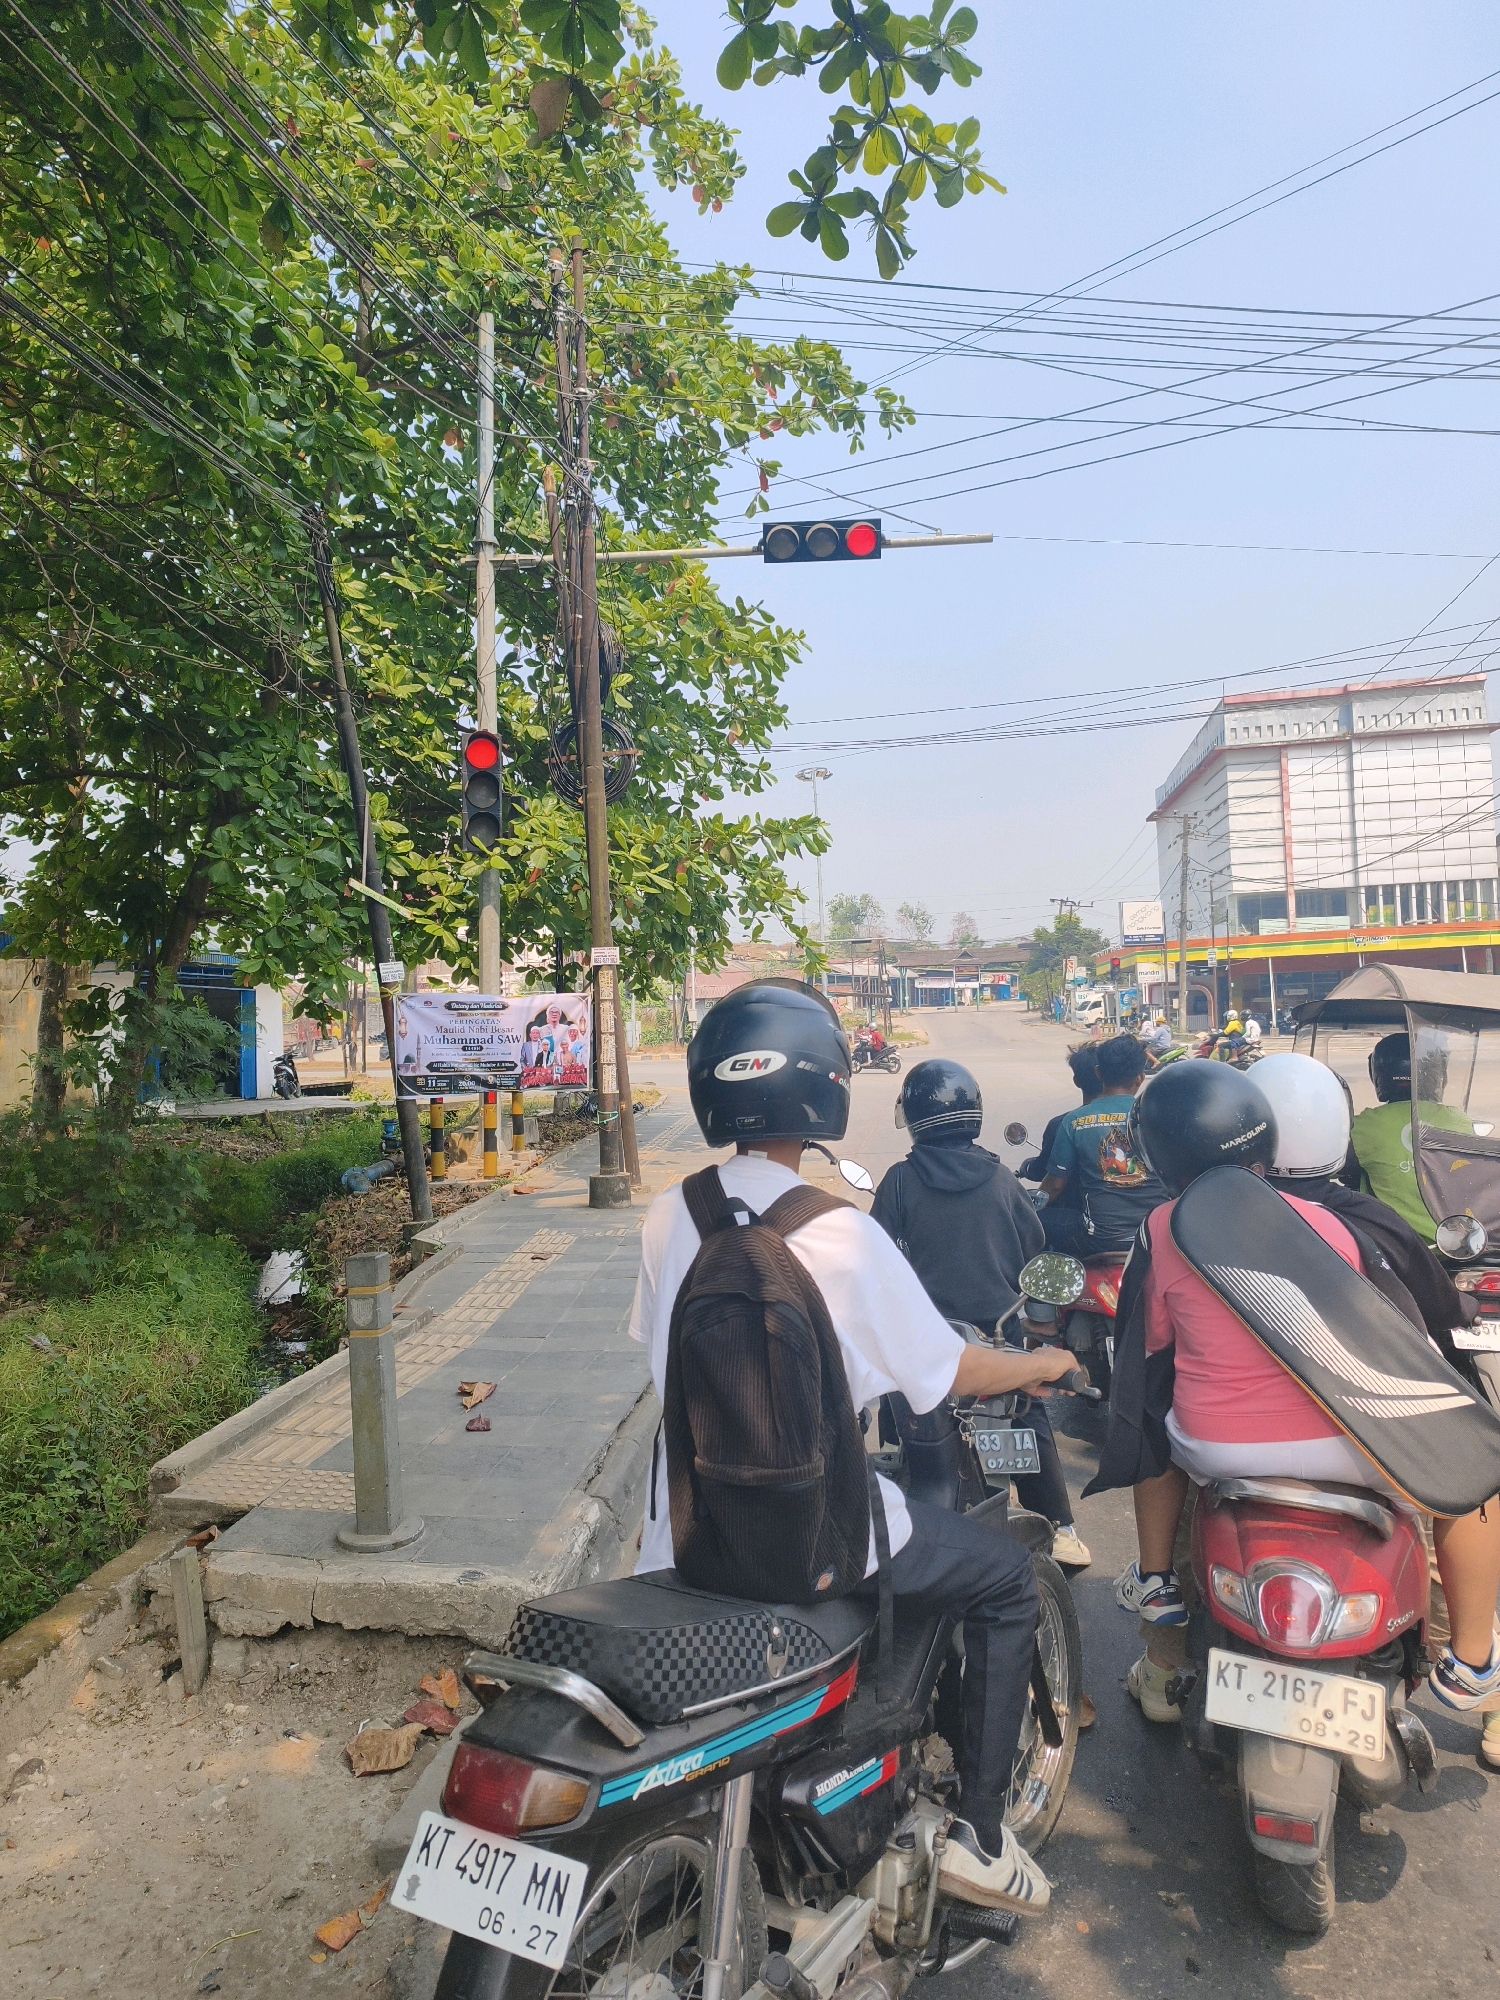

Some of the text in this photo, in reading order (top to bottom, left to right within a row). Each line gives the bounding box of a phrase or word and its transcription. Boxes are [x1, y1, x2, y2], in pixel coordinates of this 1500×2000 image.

[423, 1034, 522, 1045] Muhammad SAW
[435, 1025, 514, 1034] Maulid Nabi Besar
[729, 1058, 772, 1072] GM
[1097, 1113, 1127, 1123] BIRD
[1220, 1121, 1268, 1150] MARCOLINO
[1215, 1660, 1376, 1722] KT 2167 FJ
[632, 1751, 705, 1800] Astrea
[685, 1756, 731, 1782] GRAND
[815, 1769, 850, 1797] HONDA
[416, 1823, 571, 1917] KT 4917 MN
